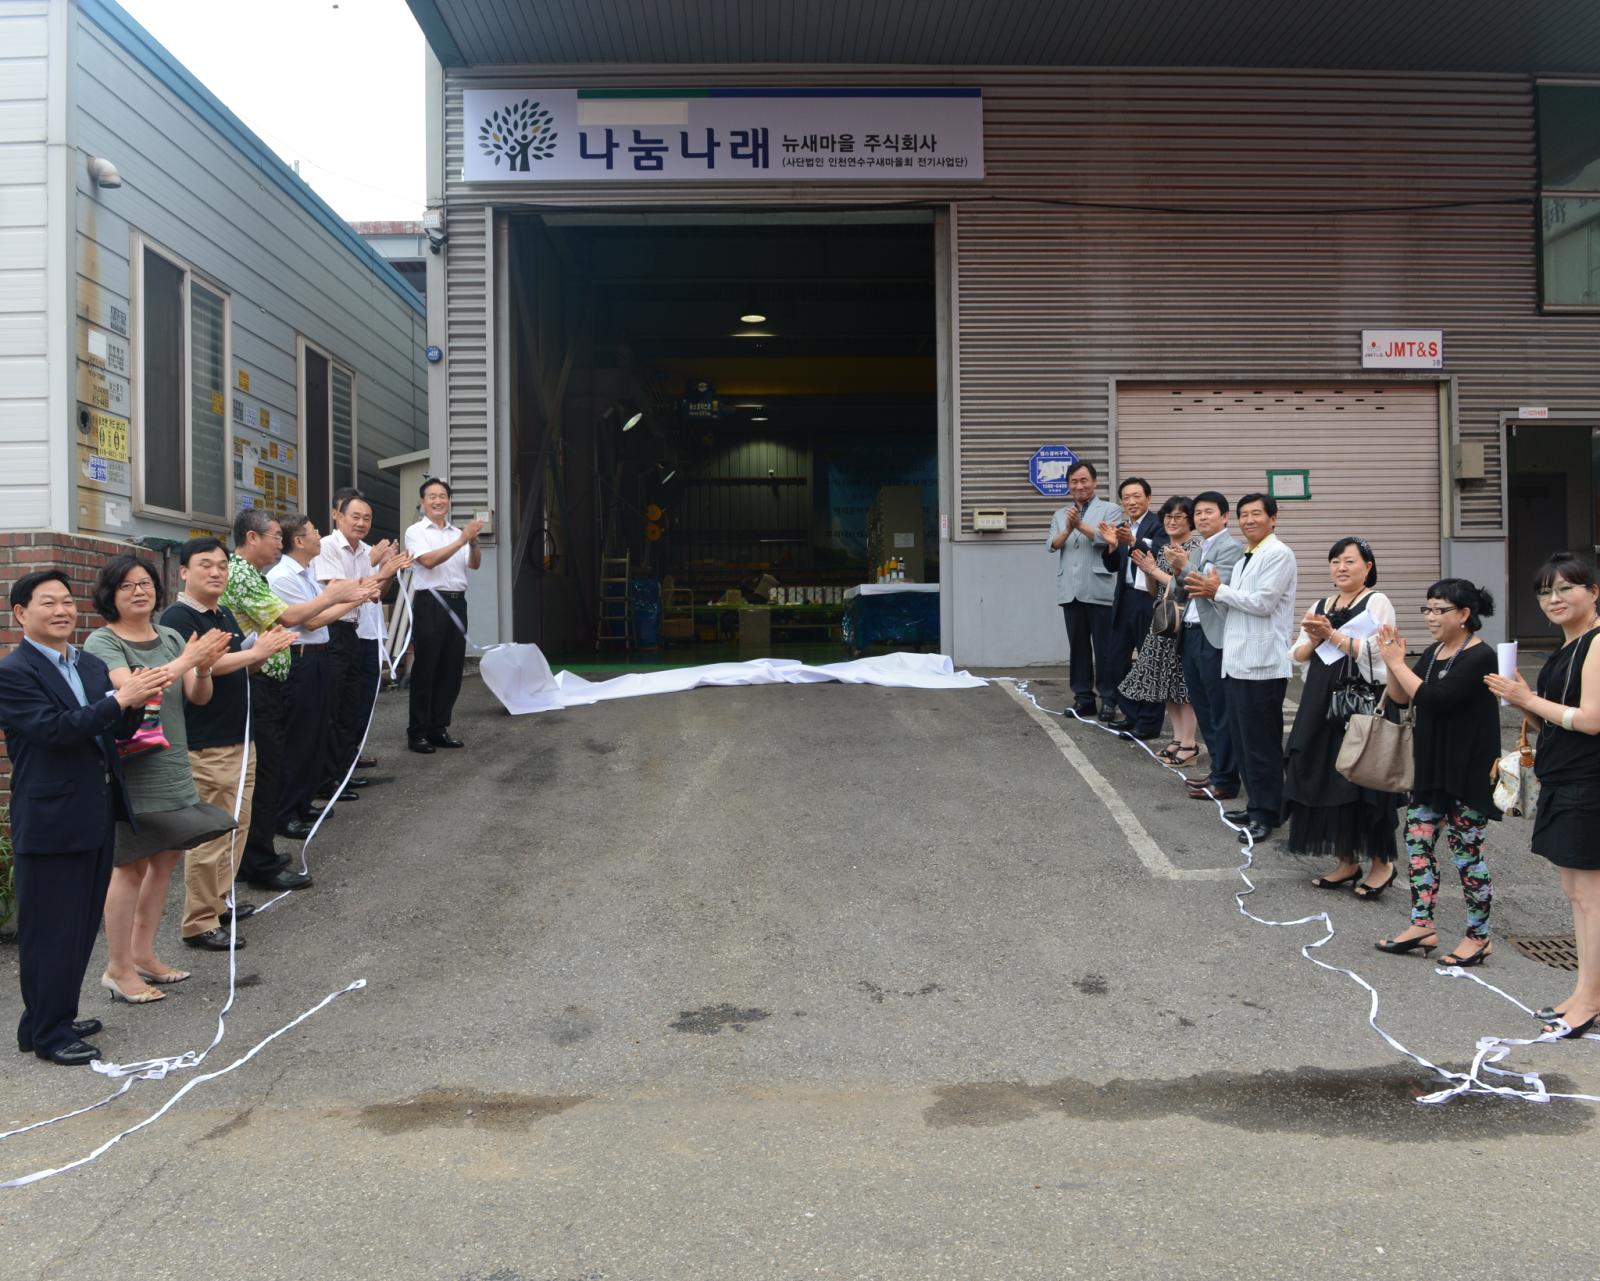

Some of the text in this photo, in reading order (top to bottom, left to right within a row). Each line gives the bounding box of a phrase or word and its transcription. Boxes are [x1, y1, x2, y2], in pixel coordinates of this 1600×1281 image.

[578, 126, 770, 171] 나눔나래
[782, 133, 938, 153] 뉴새마을 주식회사
[782, 156, 824, 169] (사단법인
[917, 156, 969, 169] 전기사업단)
[1385, 341, 1438, 358] JMT&S
